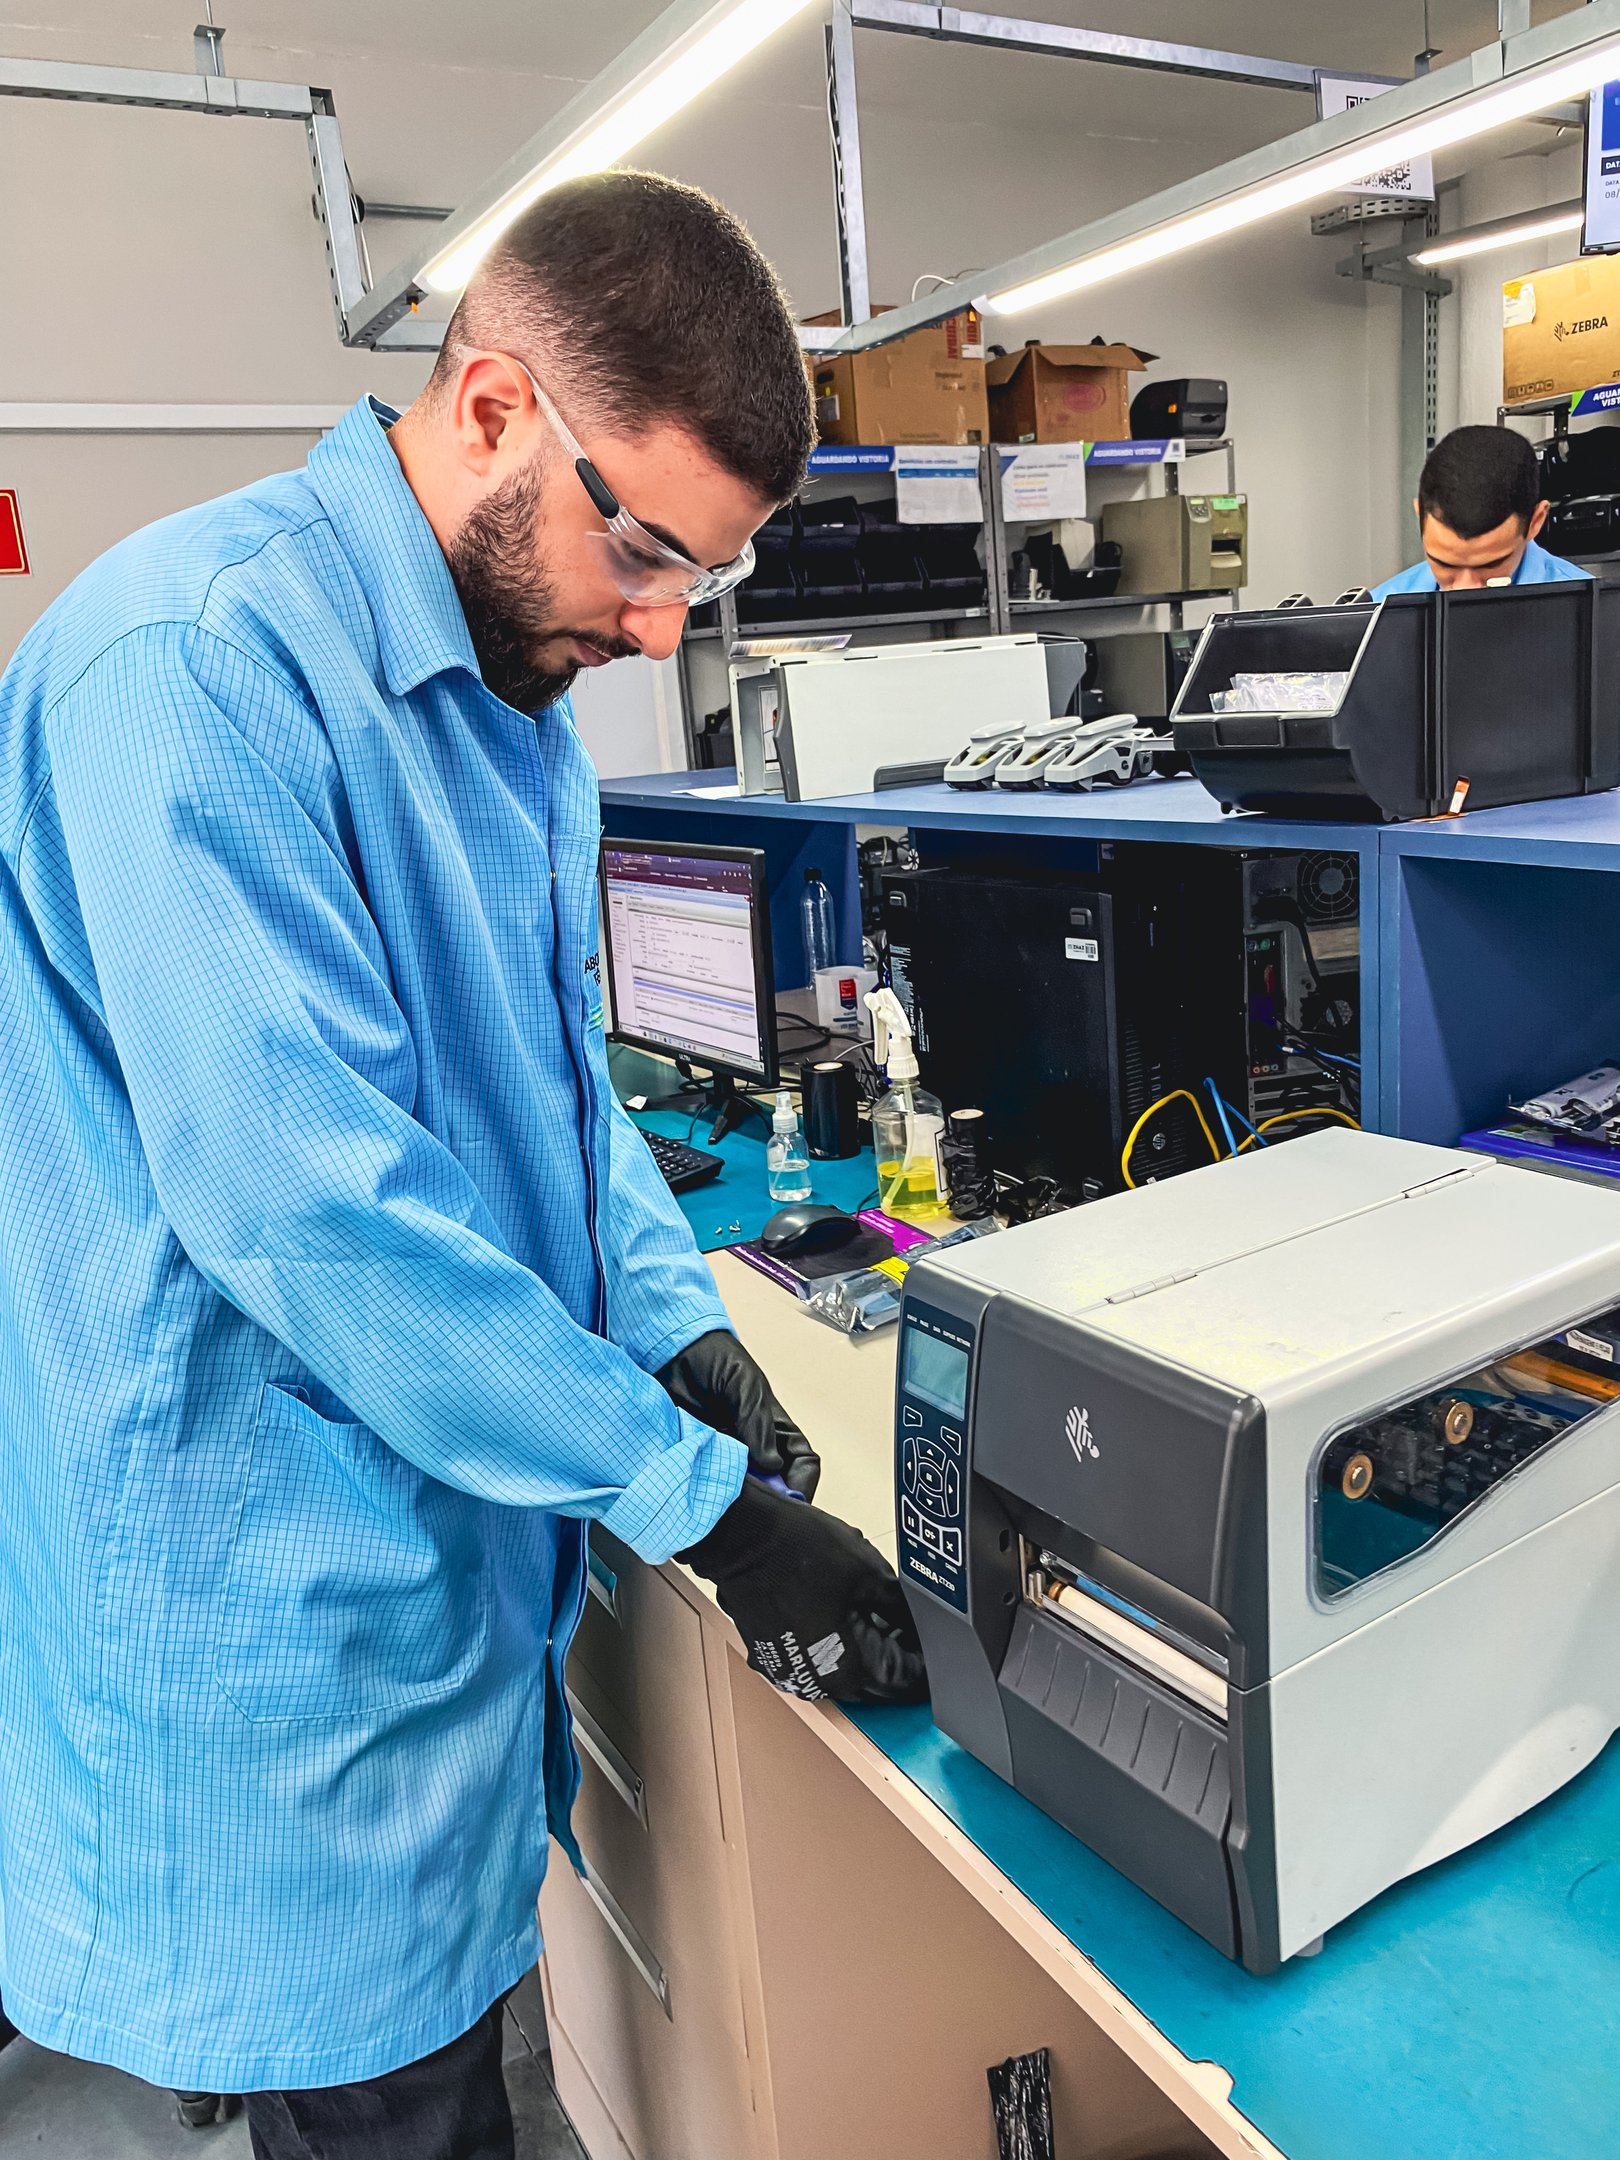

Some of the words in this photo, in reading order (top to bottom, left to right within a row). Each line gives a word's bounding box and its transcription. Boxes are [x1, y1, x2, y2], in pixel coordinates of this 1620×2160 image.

[1605, 161, 1620, 170] DAT
[1571, 316, 1609, 335] ZEBRA
[858, 454, 890, 464] VISTORIA
[909, 1556, 939, 1584] ZEBRA
